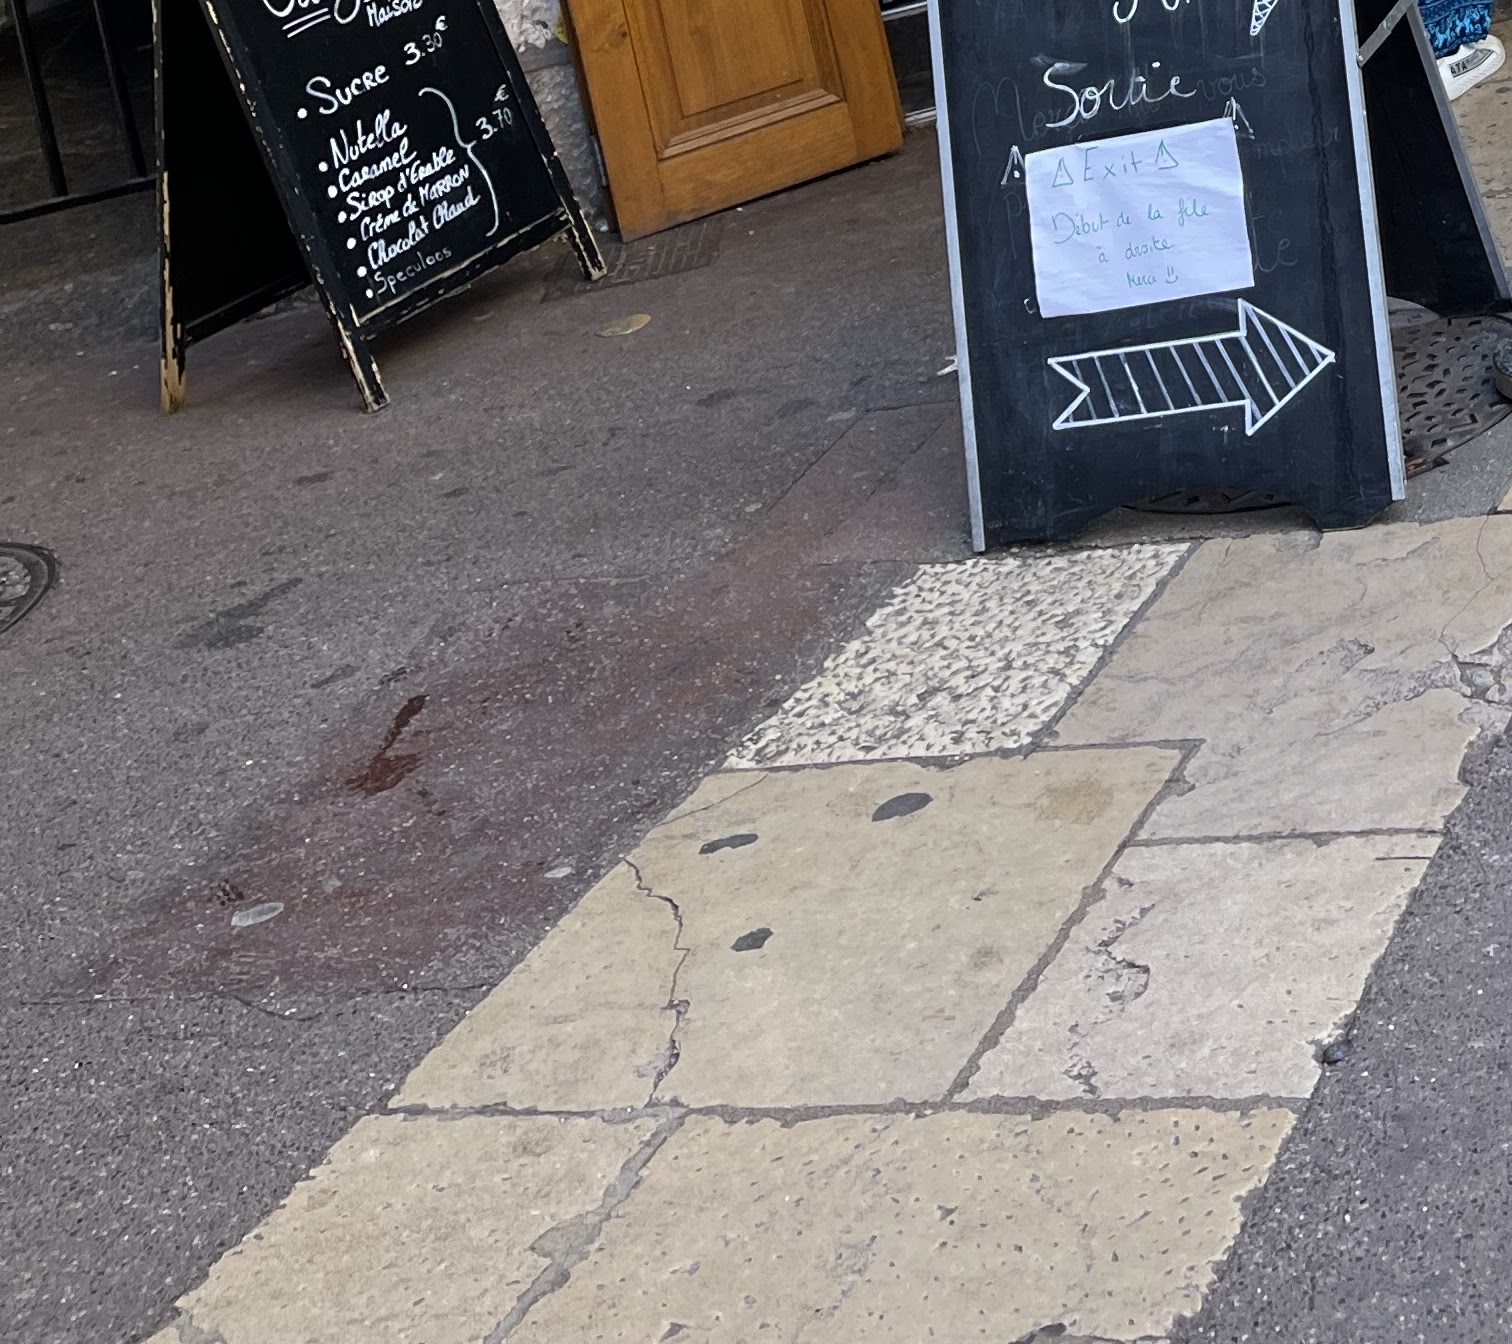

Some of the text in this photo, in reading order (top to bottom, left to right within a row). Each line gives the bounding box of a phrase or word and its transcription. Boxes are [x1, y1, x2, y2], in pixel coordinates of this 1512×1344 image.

[1043, 61, 1198, 129] Sortie
[330, 109, 408, 168] Nutella
[1083, 145, 1143, 183] Exit
[1116, 211, 1132, 228] de
[1147, 203, 1163, 220] la
[1177, 197, 1210, 227] file
[367, 215, 430, 271] Chocolat
